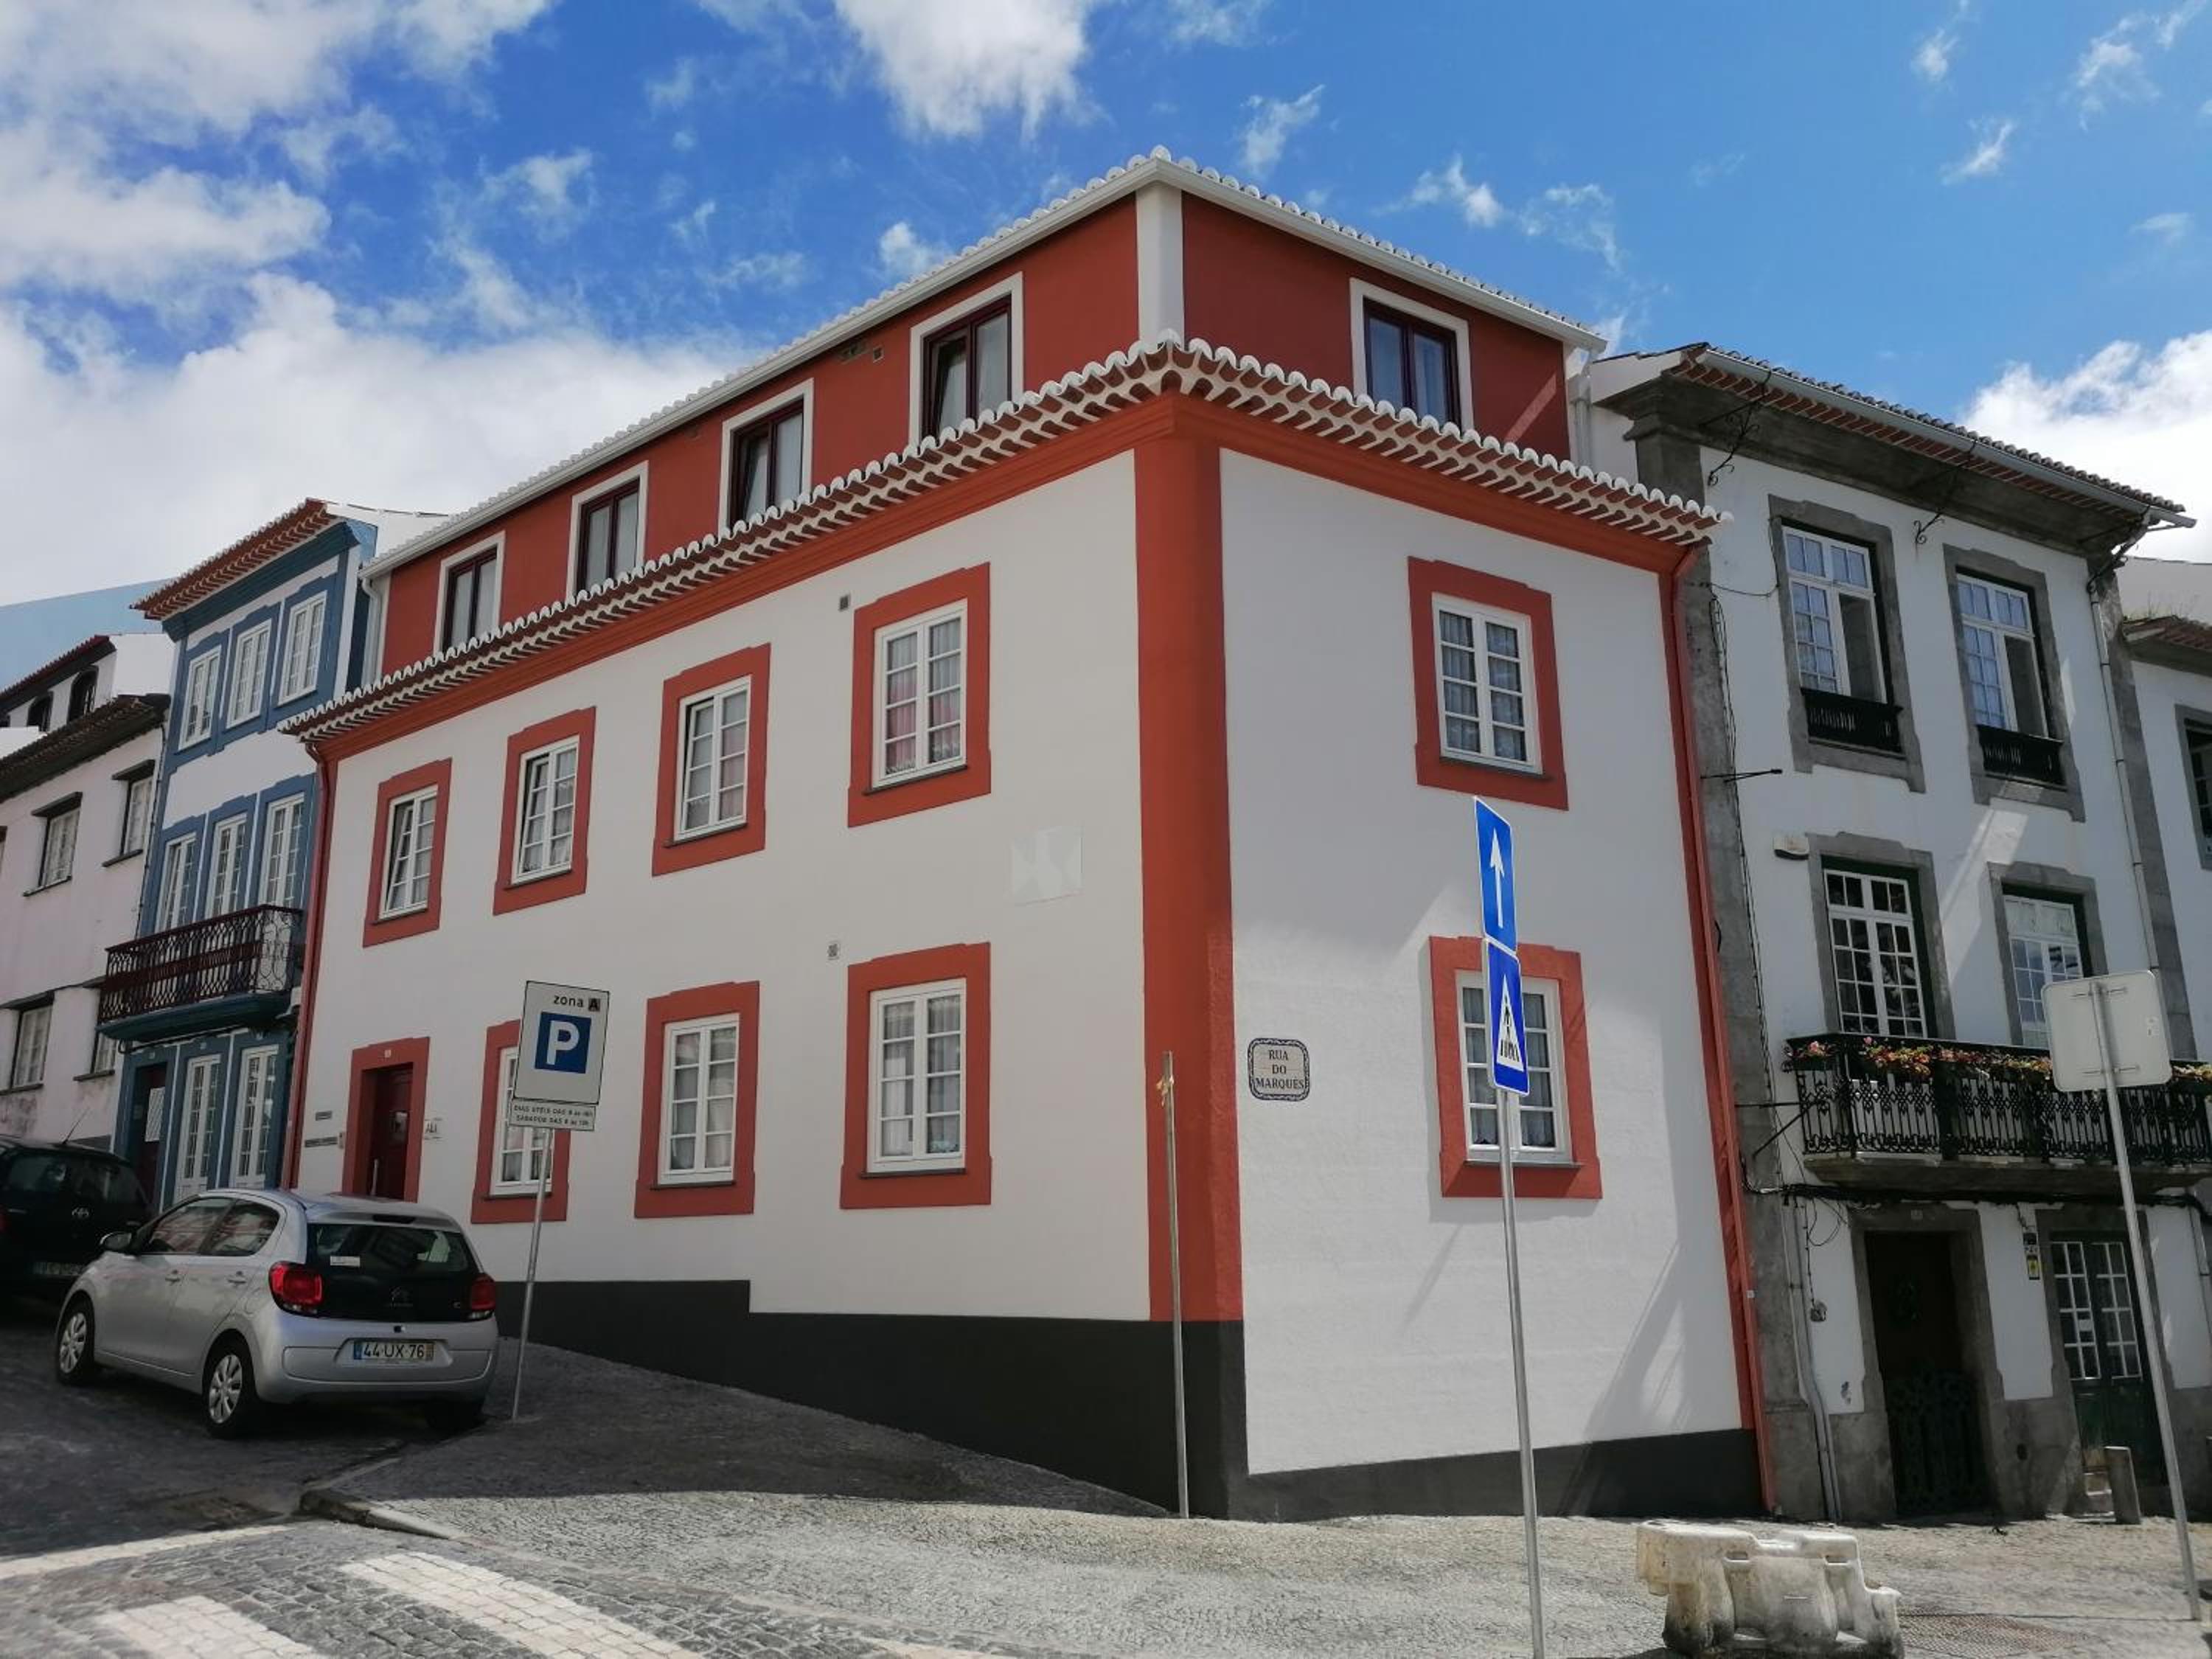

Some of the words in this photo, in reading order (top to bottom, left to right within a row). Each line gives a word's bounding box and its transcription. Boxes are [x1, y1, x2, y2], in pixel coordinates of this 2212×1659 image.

[554, 995, 584, 1008] zona
[589, 998, 599, 1010] A
[546, 1020, 580, 1065] P
[1268, 1049, 1289, 1060] RUA
[1272, 1064, 1287, 1074] DO
